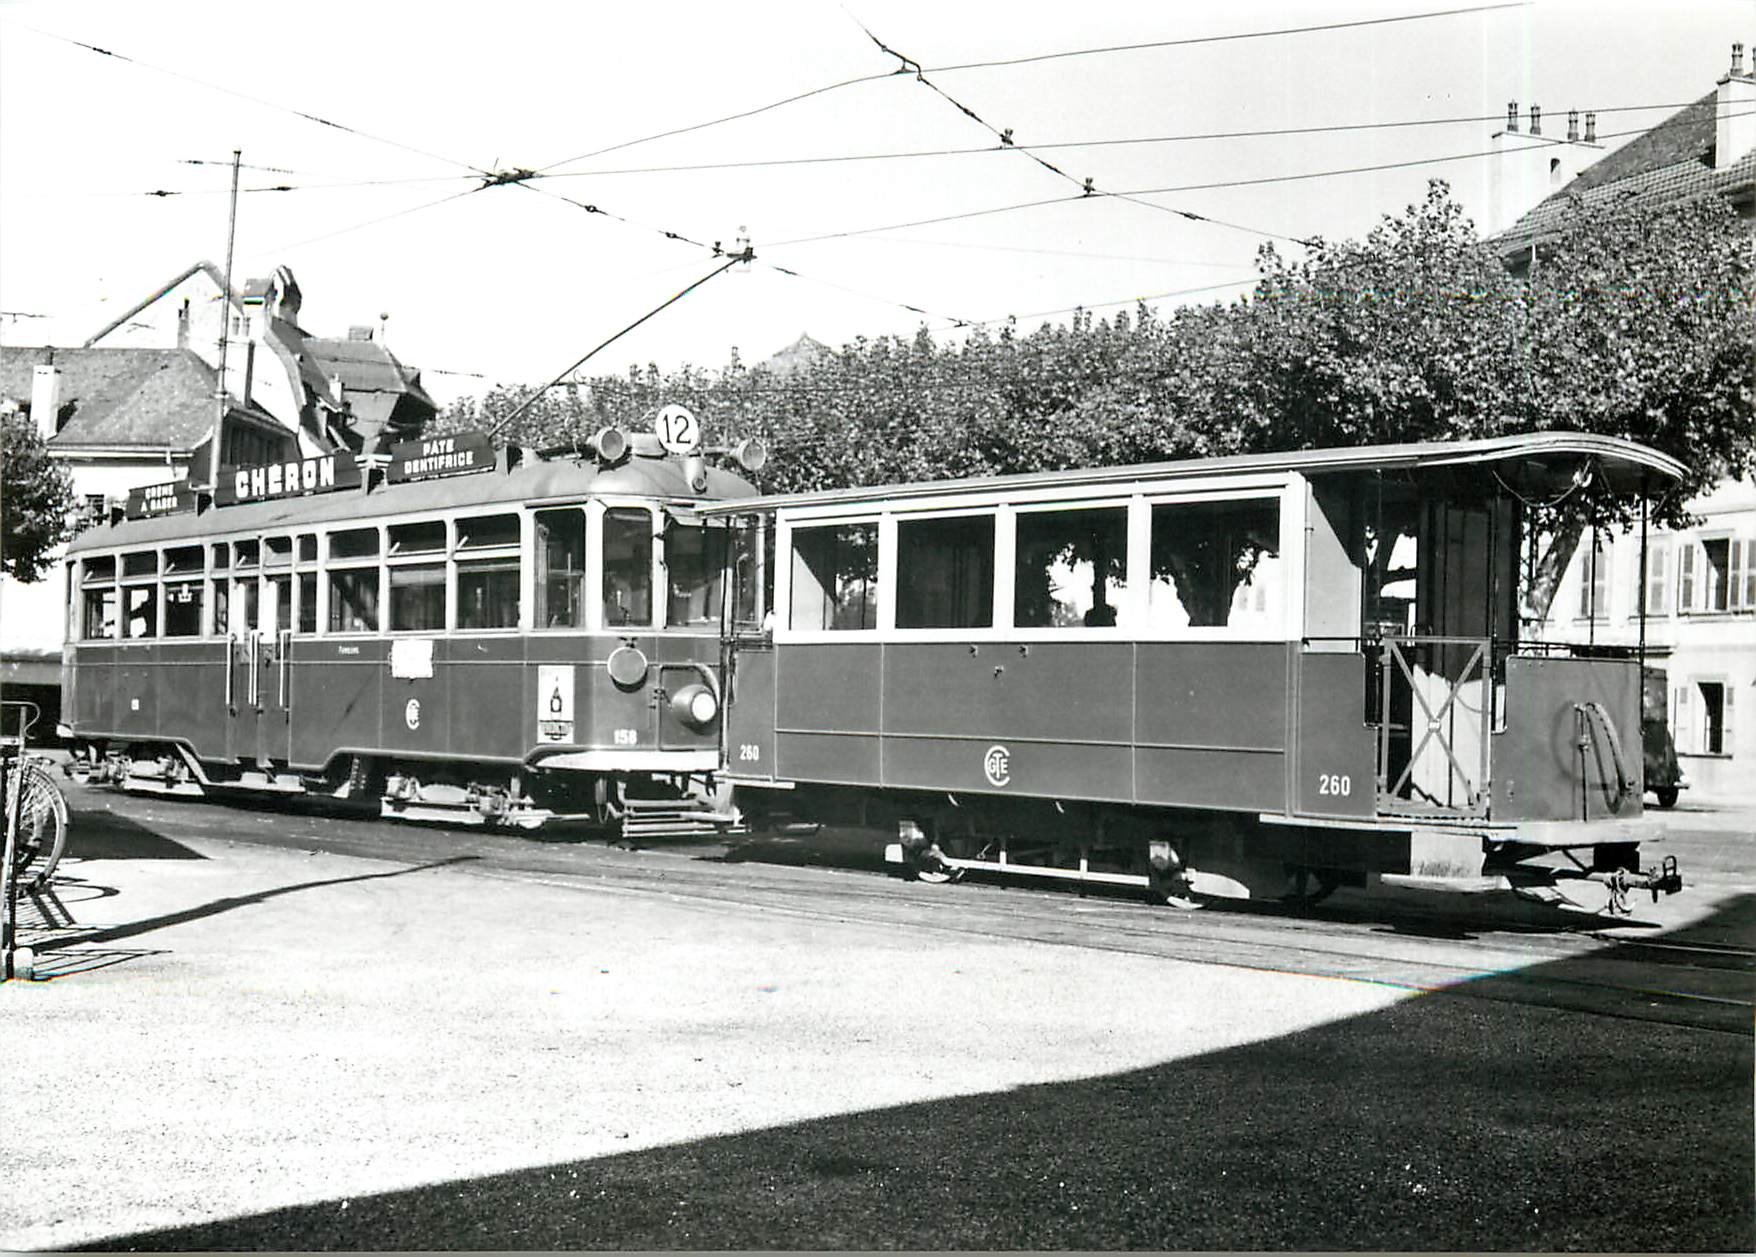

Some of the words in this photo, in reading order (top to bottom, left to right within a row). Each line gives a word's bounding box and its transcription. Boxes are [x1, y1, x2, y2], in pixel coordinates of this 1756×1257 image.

[663, 413, 691, 444] 12
[404, 451, 474, 475] DENTIFRICE
[614, 729, 638, 745] 158
[740, 744, 760, 760] 260
[1319, 774, 1350, 796] 260
